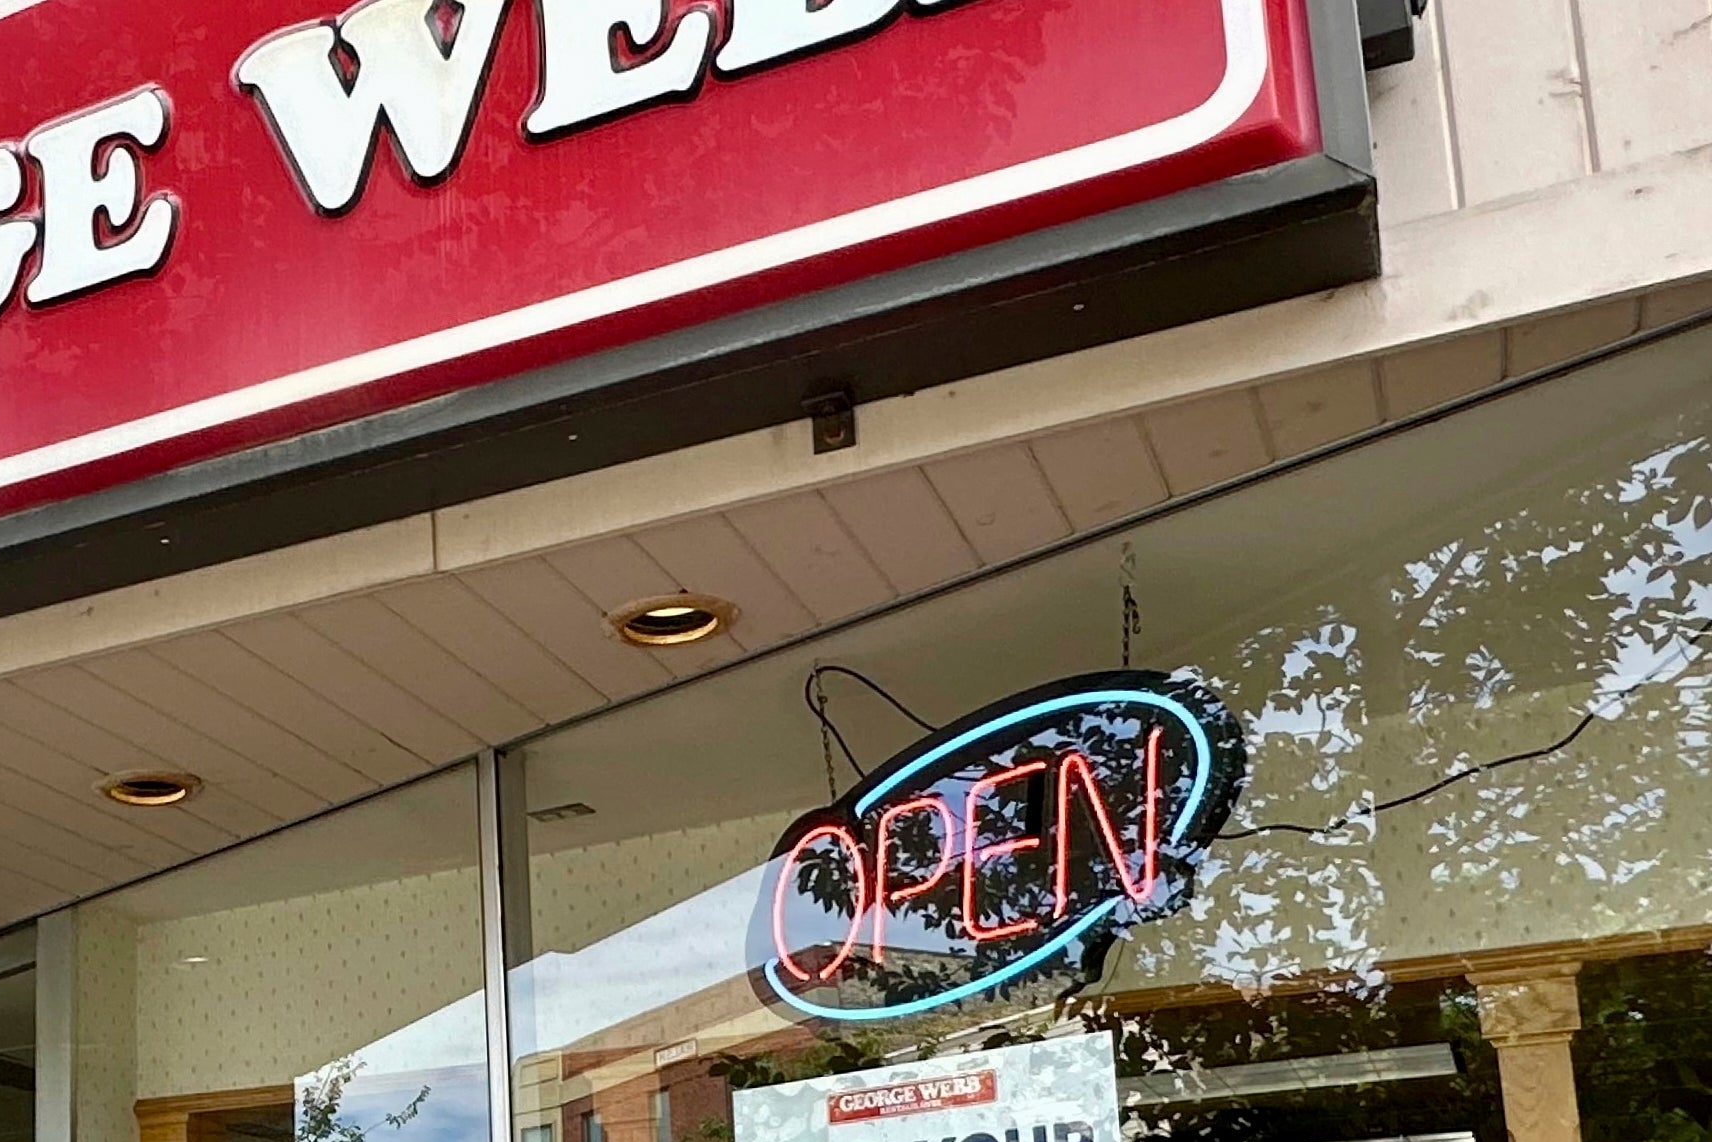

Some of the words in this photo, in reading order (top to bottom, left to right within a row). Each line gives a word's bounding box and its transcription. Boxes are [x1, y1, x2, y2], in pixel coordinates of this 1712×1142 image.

[233, 0, 996, 216] WE
[773, 725, 1164, 980] OPEN
[839, 1085, 916, 1112] GEORGE
[918, 1075, 981, 1100] WEBB
